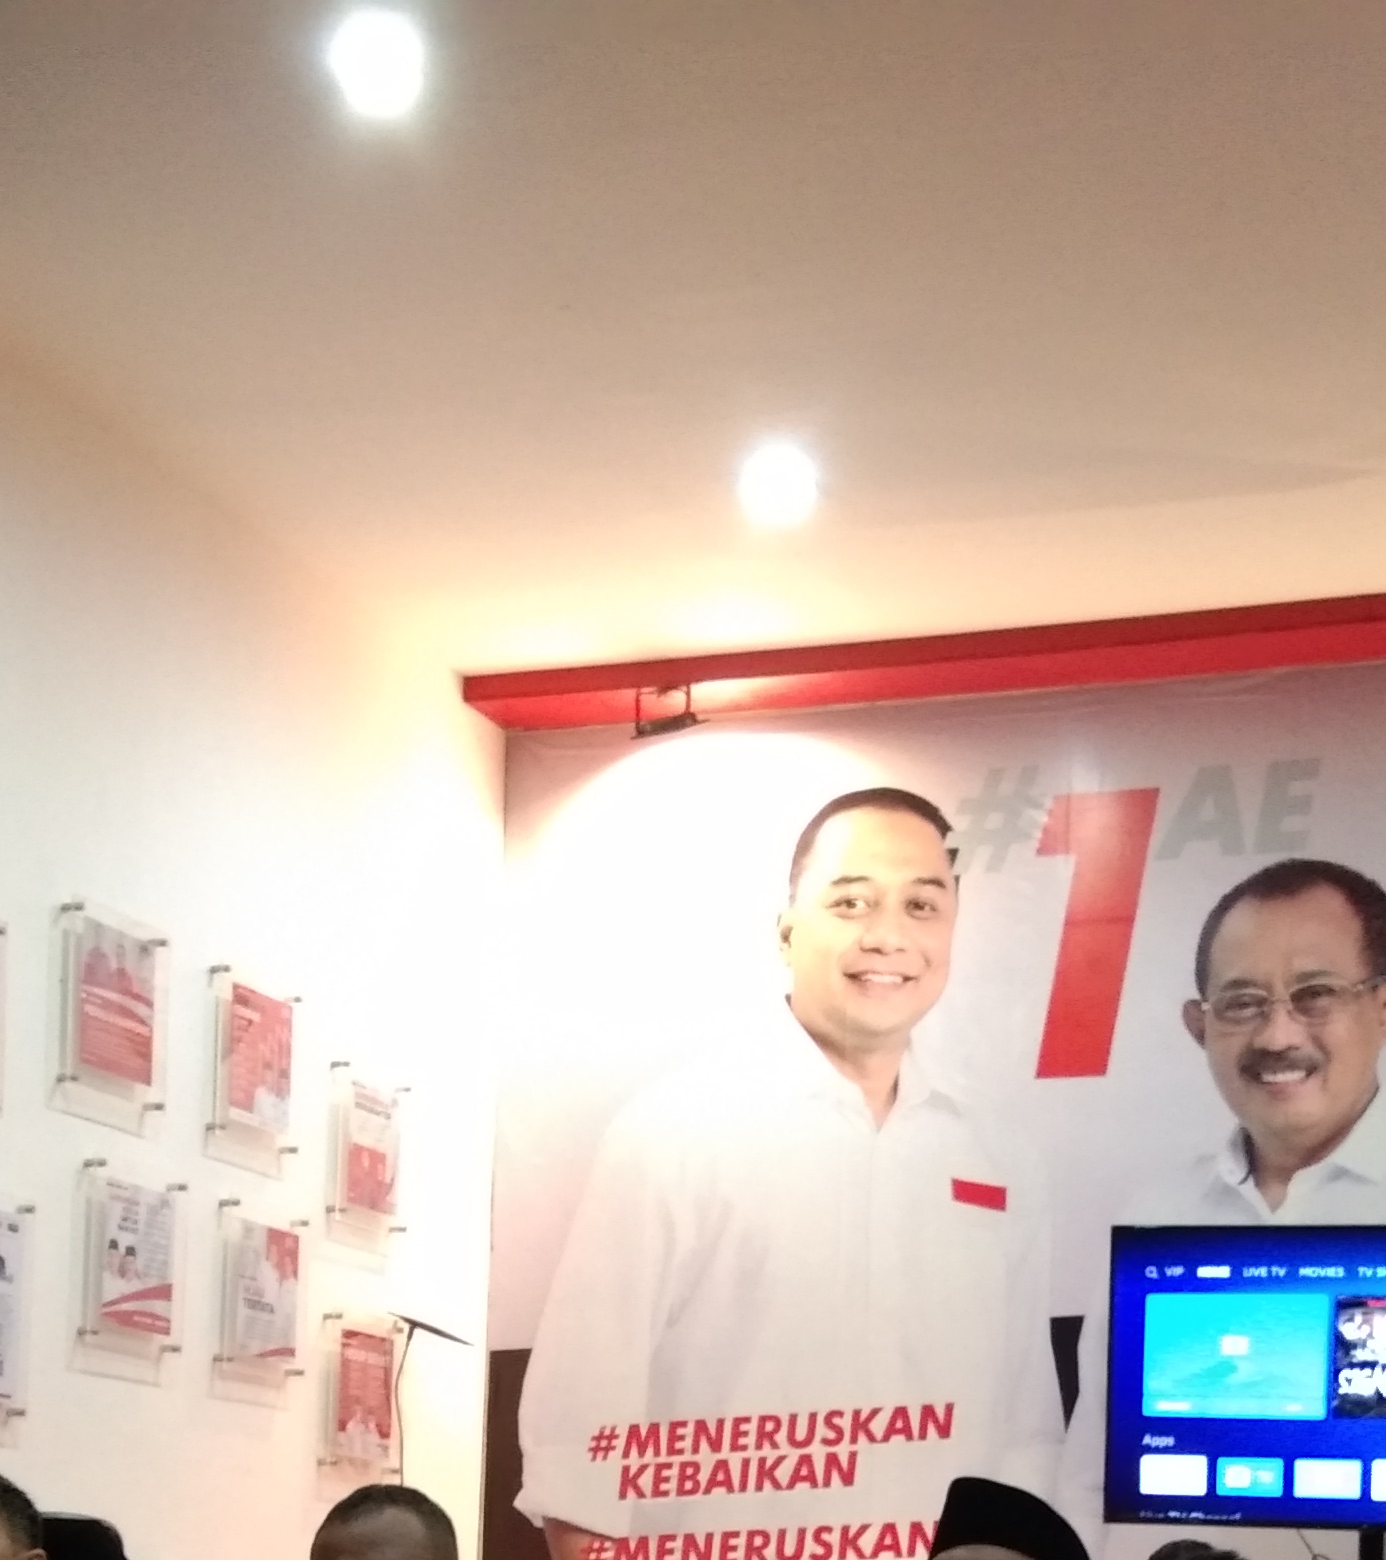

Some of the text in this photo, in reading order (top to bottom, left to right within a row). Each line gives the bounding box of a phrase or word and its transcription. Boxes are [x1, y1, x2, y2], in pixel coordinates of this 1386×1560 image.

[1164, 1265, 1185, 1277] VIP
[1242, 1266, 1268, 1278] LIVE
[1270, 1266, 1287, 1278] TV
[1298, 1266, 1345, 1278] MOVIES
[1357, 1266, 1374, 1278] TV
[587, 1402, 955, 1462] #MENERUSKAN
[1141, 1433, 1175, 1449] Apps
[617, 1450, 858, 1500] KEBAIKAN
